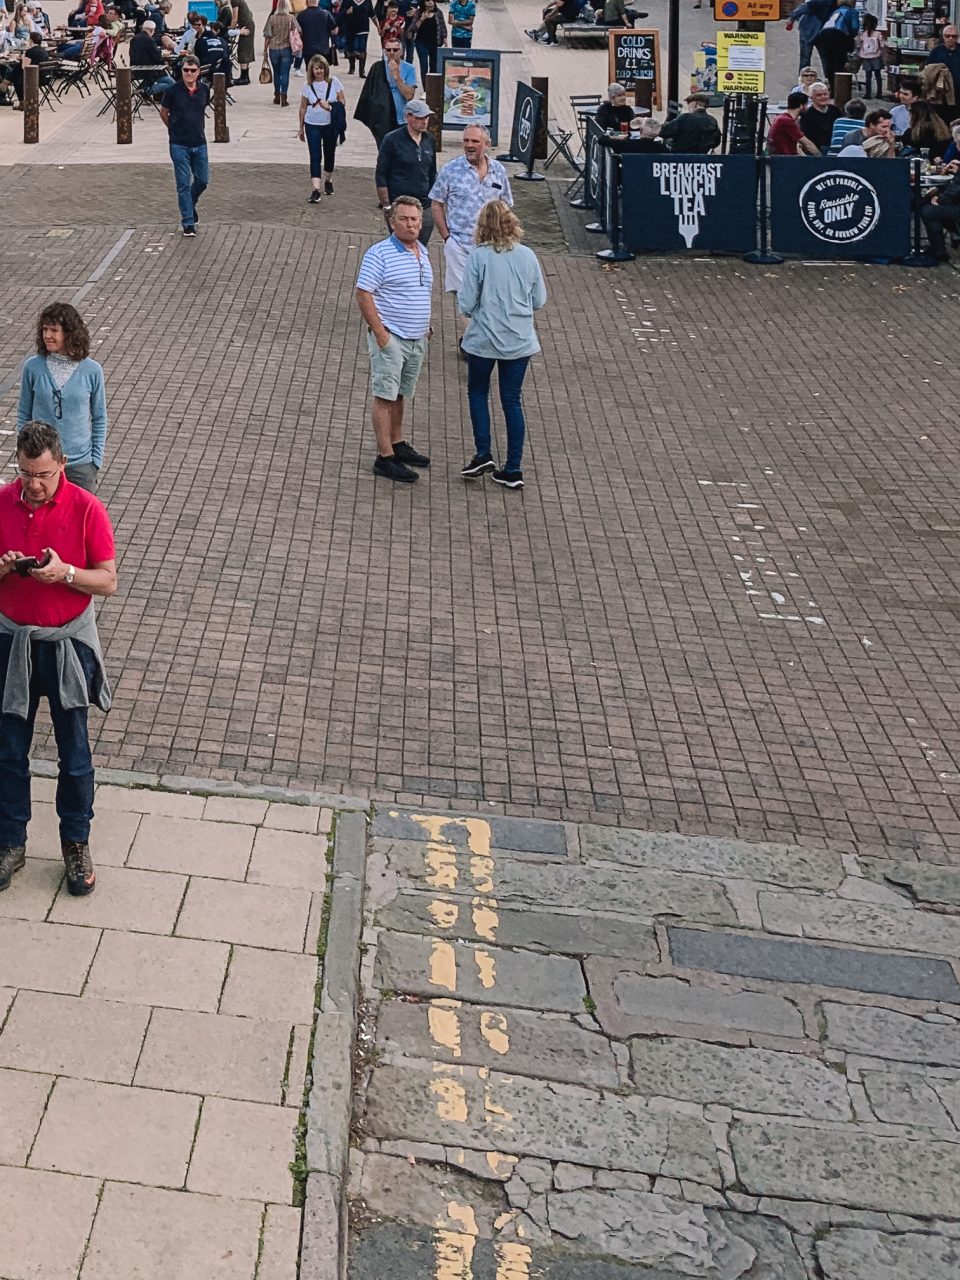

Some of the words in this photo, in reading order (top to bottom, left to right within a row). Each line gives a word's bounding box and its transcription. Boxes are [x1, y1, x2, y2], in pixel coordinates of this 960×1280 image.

[621, 36, 645, 46] COLD
[617, 47, 651, 59] DRINKS
[625, 58, 637, 68] £1
[652, 162, 723, 178] BREAKFAST
[660, 176, 716, 196] LUNCH
[836, 178, 863, 191] PROUDLY
[670, 194, 706, 216] TEA
[819, 193, 859, 209] Reusable
[824, 202, 854, 223] ONLY
